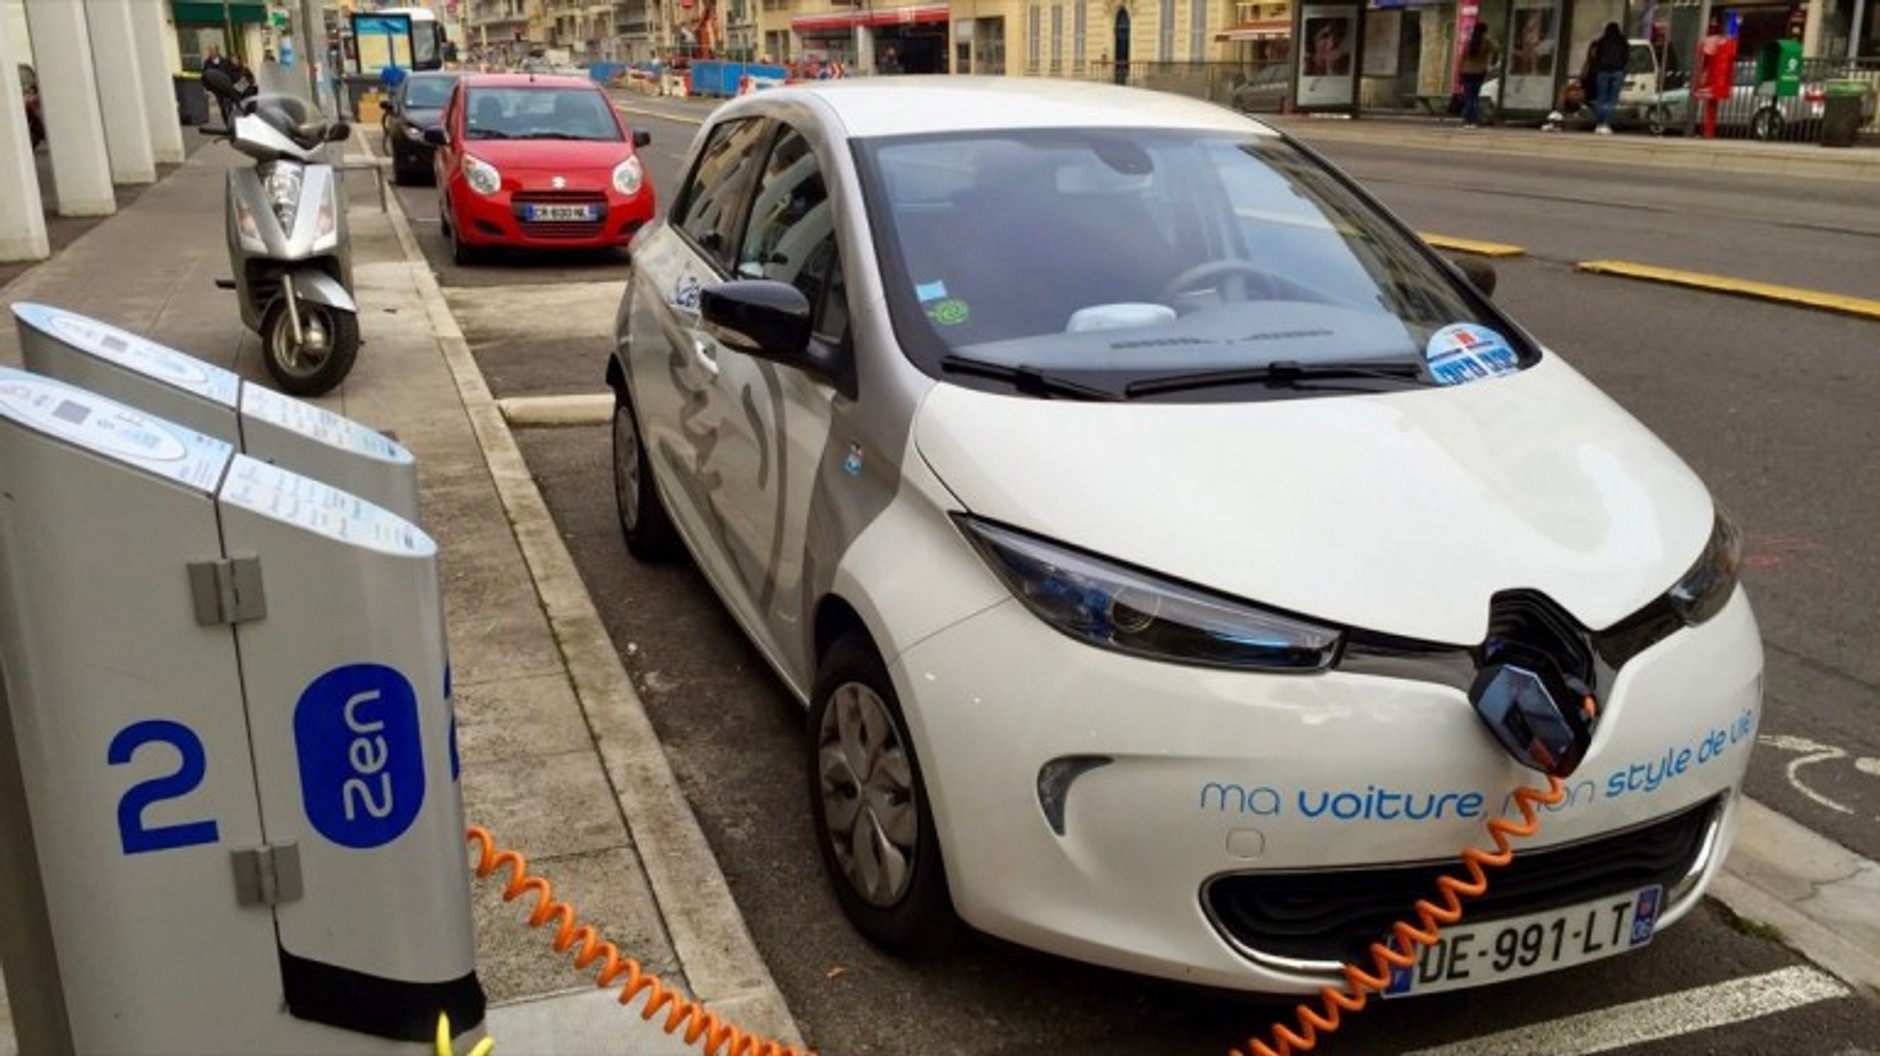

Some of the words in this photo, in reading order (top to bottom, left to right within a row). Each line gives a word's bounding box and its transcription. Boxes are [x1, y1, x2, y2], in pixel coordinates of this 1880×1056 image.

[107, 718, 220, 856] 2
[1200, 782, 1281, 815] ma
[1605, 746, 1691, 798] style
[1697, 728, 1726, 764] de
[1418, 901, 1632, 984] DE-991-LT
